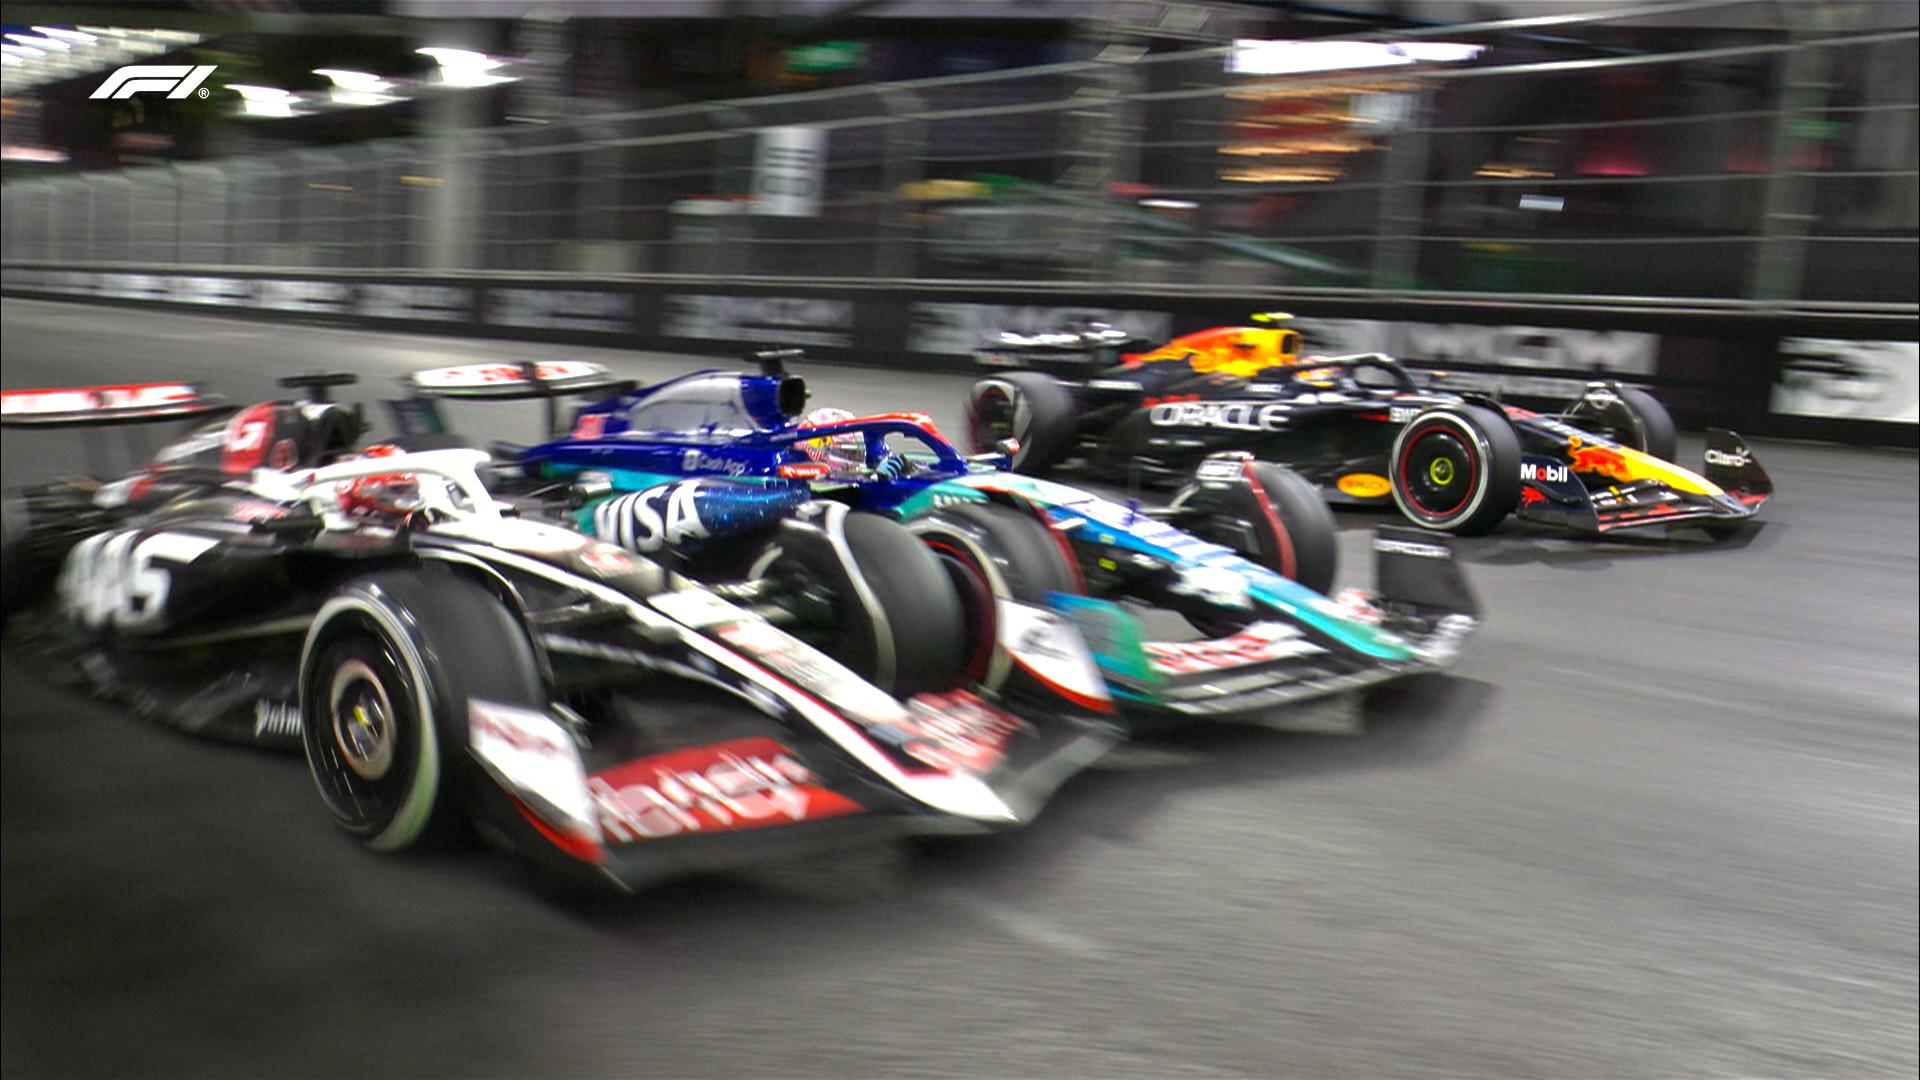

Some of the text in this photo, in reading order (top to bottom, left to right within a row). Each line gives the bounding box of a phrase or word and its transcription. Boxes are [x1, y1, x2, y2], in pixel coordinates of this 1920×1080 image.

[1149, 402, 1294, 433] ORACLE
[1704, 449, 1745, 467] Claro
[1520, 463, 1568, 483] Mobil
[594, 480, 710, 553] VISA
